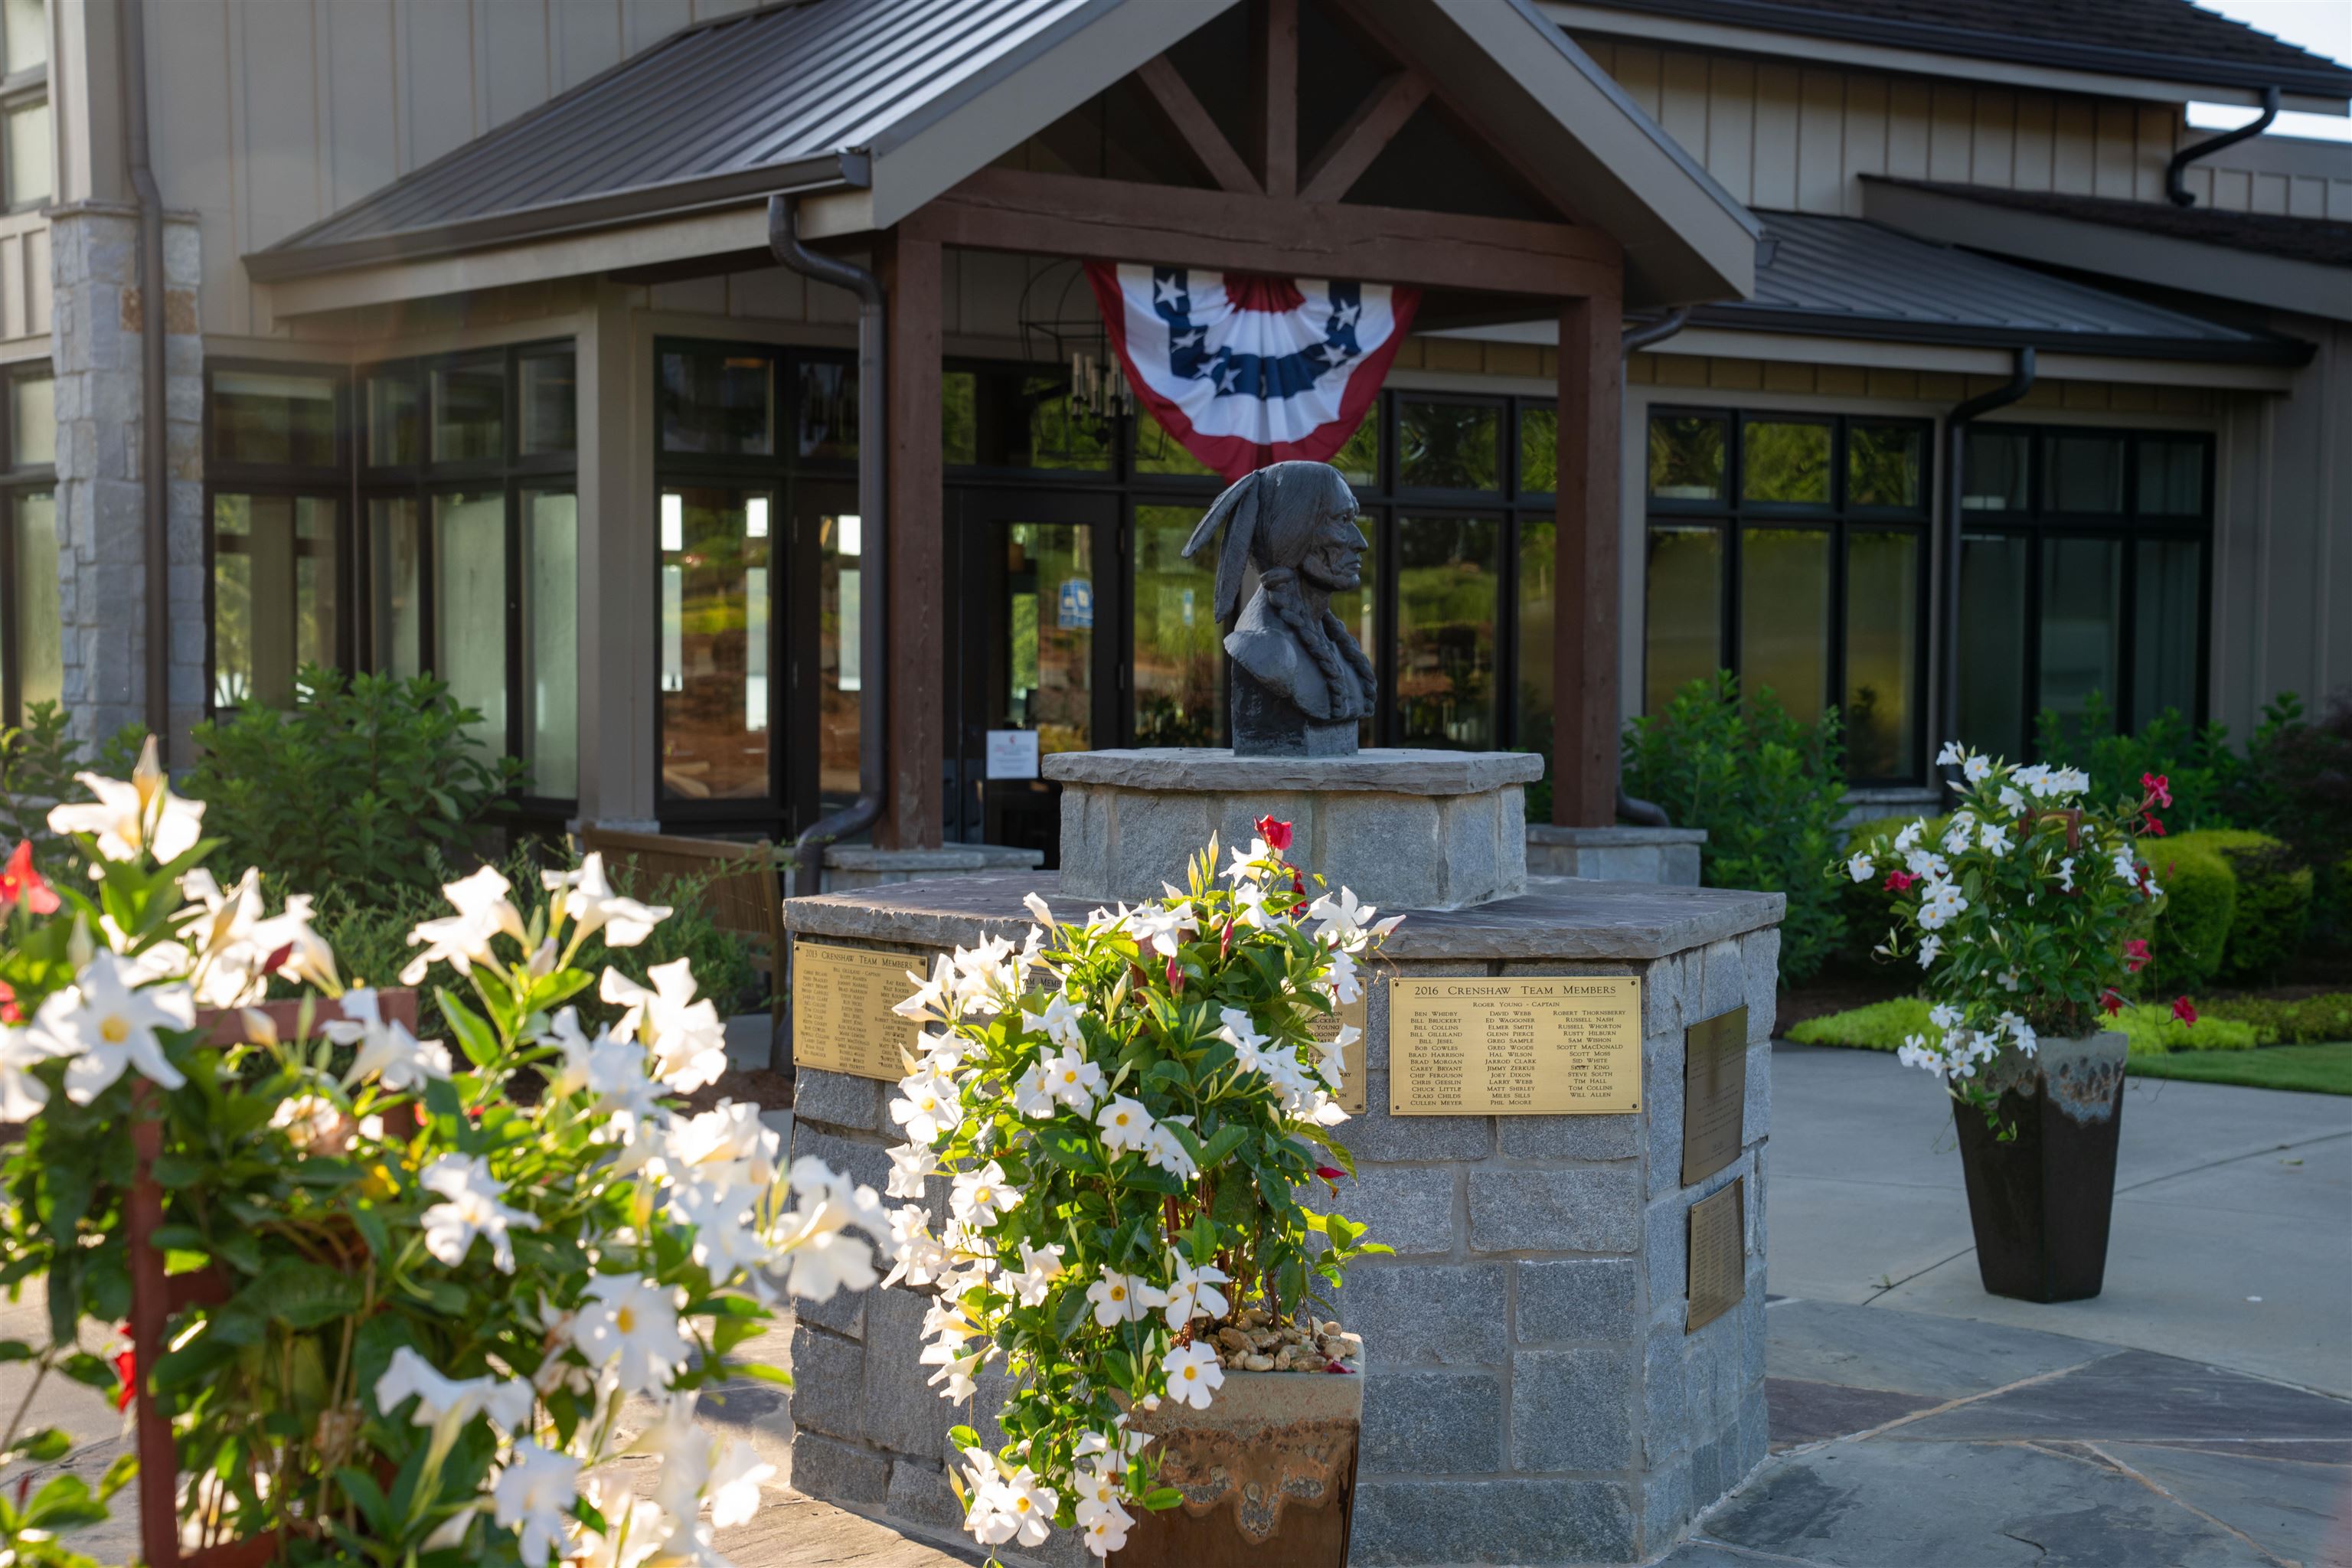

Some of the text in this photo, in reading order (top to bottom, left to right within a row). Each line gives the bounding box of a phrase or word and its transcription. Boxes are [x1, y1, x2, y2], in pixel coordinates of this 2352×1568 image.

[821, 950, 854, 962] CRENSHAW
[859, 955, 877, 965] TEAM
[882, 957, 912, 969] MEMBERS
[1415, 986, 1439, 995] 2016
[1448, 986, 1511, 995] CRENSHAW
[1521, 986, 1553, 995] TEAM
